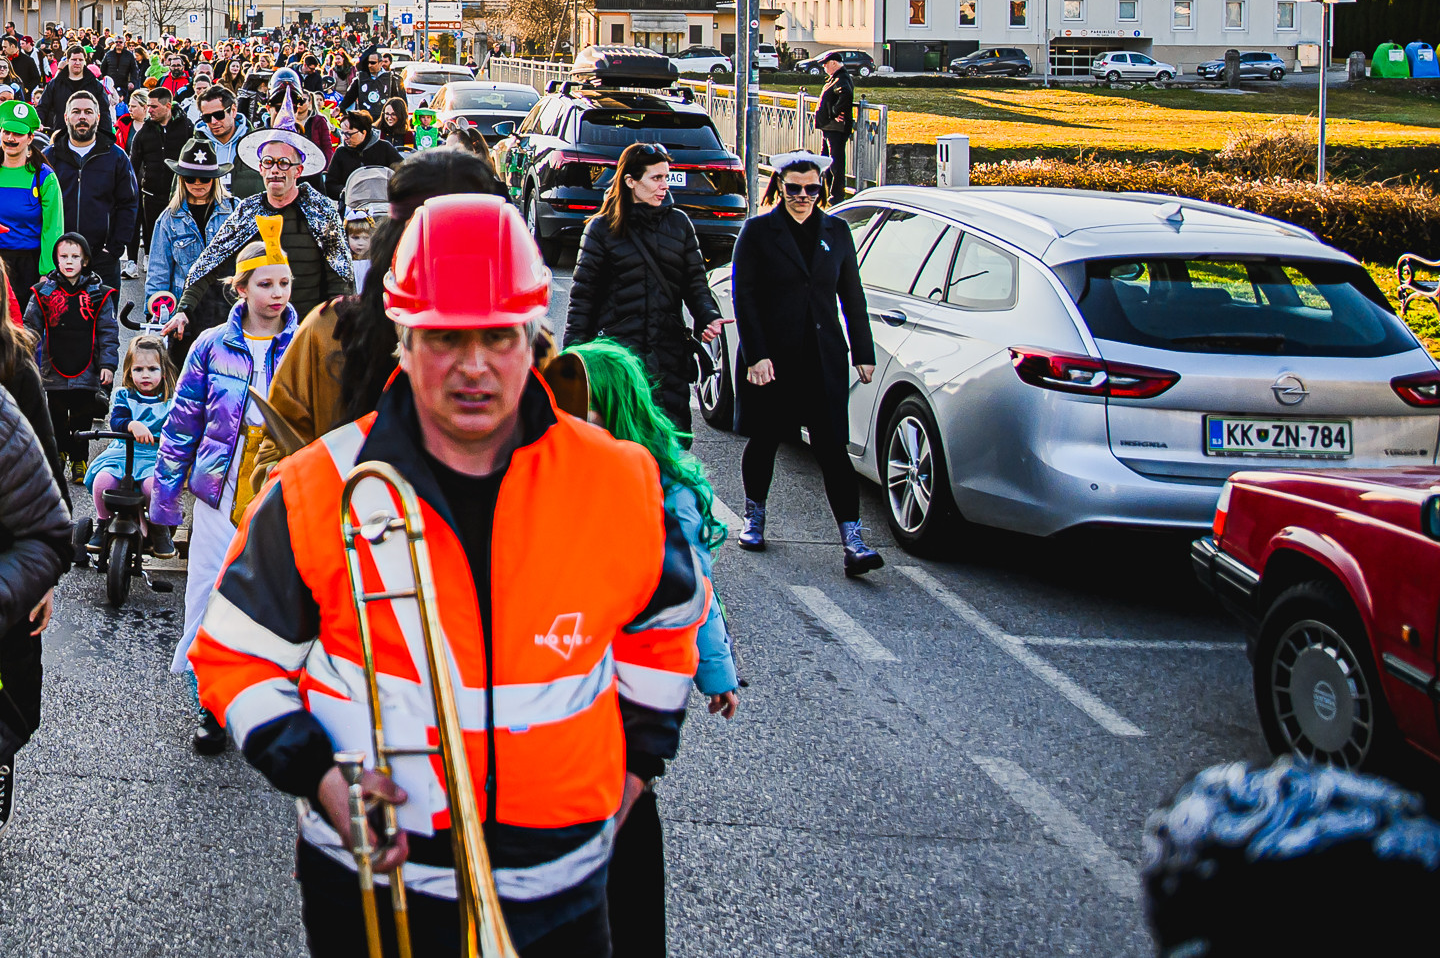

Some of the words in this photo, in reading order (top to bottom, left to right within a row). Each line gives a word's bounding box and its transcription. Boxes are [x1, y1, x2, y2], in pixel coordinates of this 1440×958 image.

[18, 106, 23, 115] L
[1226, 424, 1254, 446] KK
[1271, 424, 1346, 449] ZN-784
